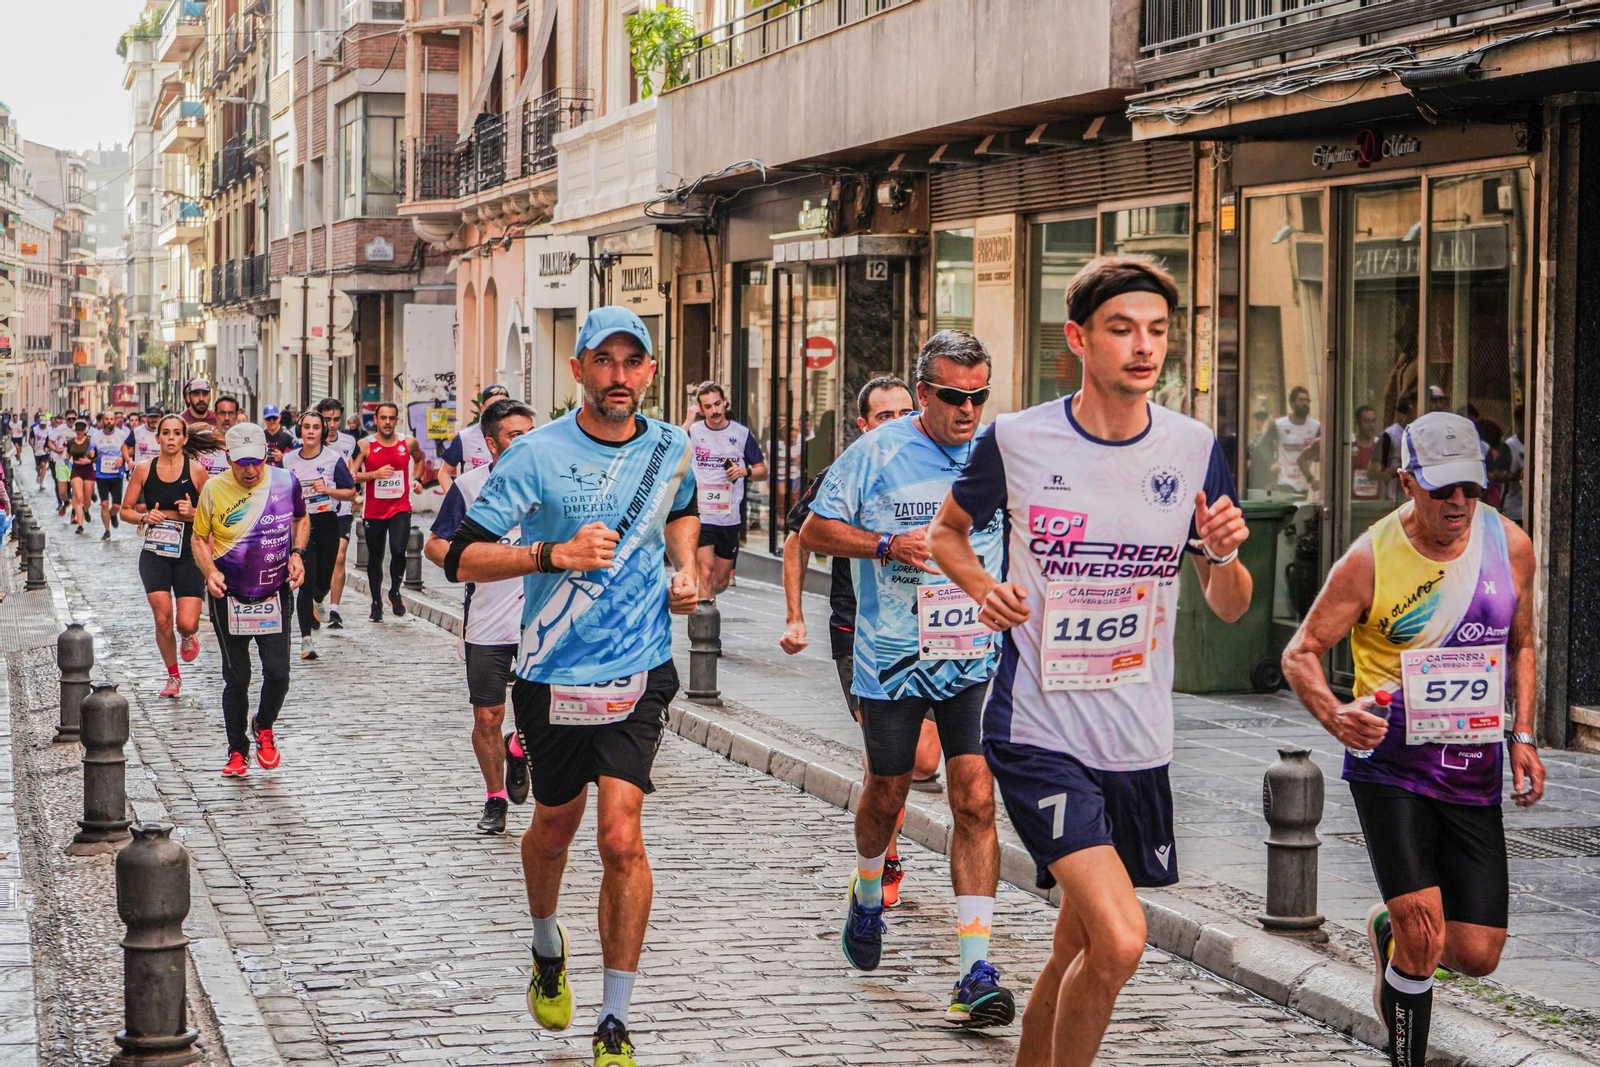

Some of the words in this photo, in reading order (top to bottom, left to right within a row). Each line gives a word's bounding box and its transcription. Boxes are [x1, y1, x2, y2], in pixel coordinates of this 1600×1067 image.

[869, 262, 886, 279] 12
[706, 492, 721, 501] 34
[563, 503, 614, 516] PUERTA
[894, 502, 942, 517] ZATOPE
[891, 575, 922, 585] RAQUEL
[1069, 586, 1131, 597] CARRERA
[233, 603, 275, 615] 1229
[1053, 613, 1138, 642] 1168
[1426, 653, 1485, 662] CARRERA
[1424, 679, 1488, 703] 579
[1037, 792, 1067, 840] 7
